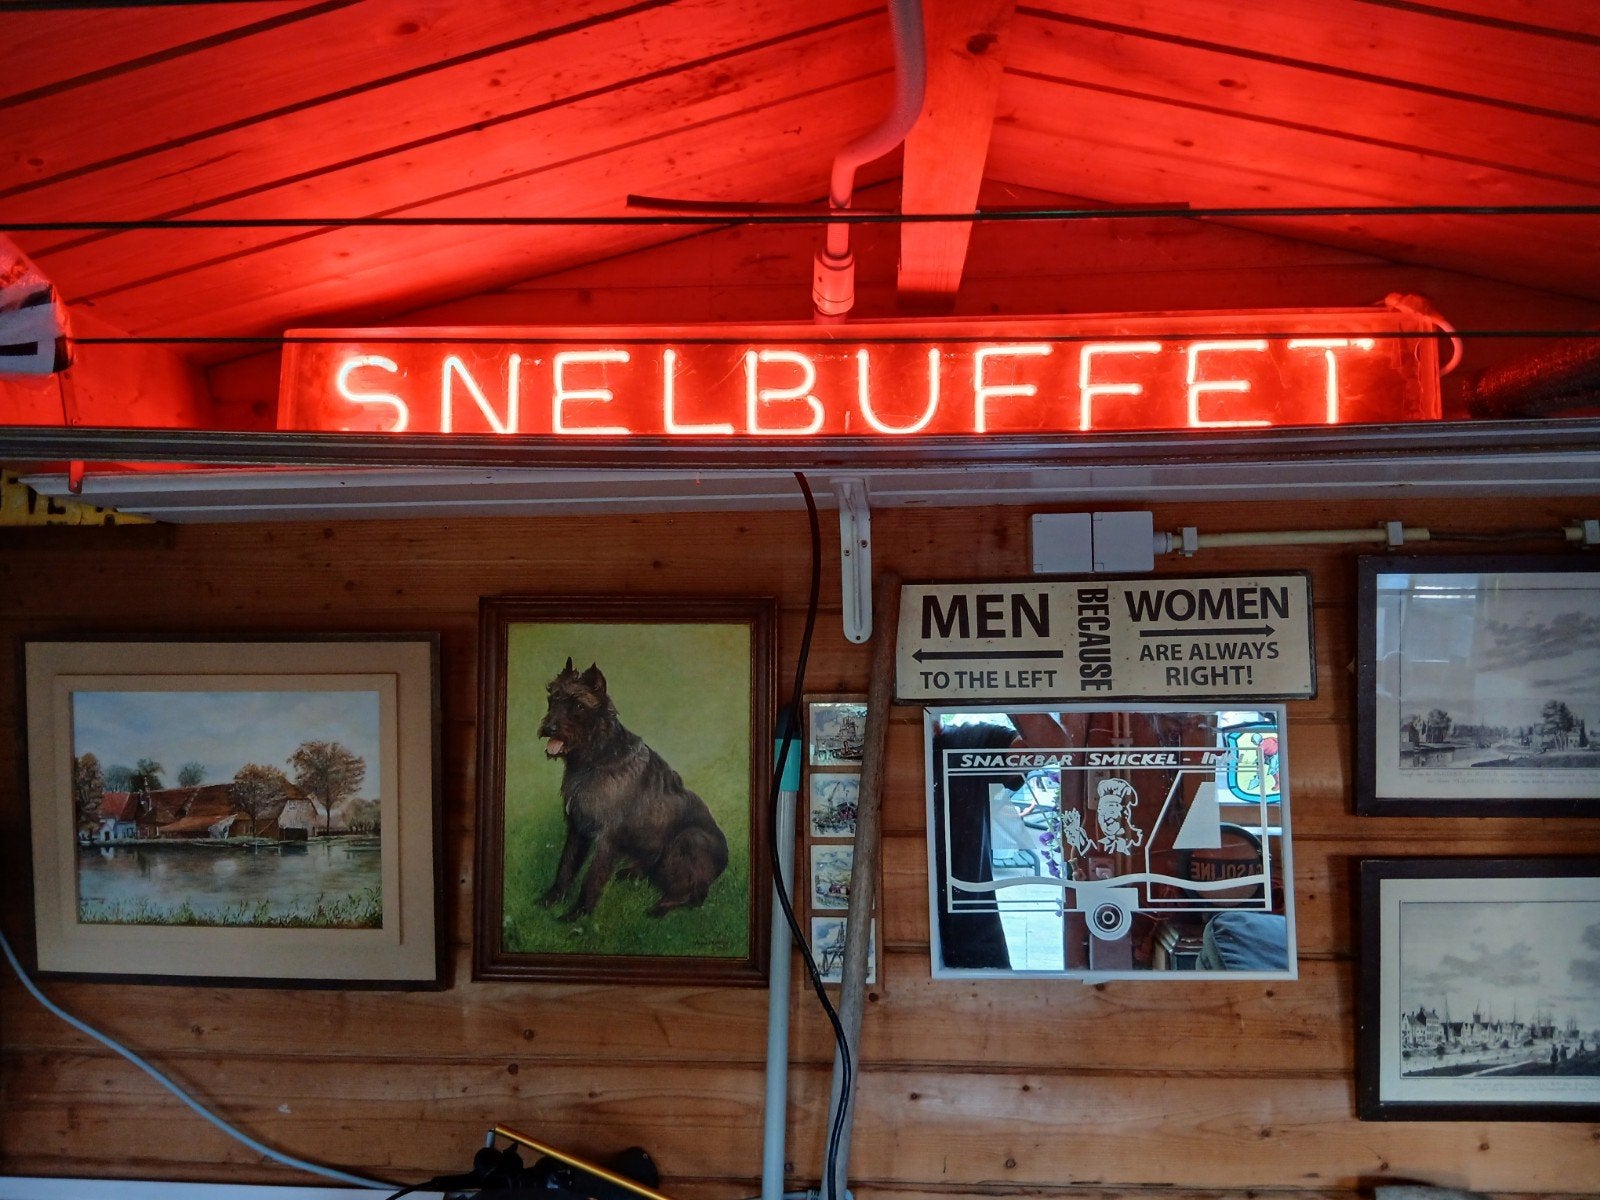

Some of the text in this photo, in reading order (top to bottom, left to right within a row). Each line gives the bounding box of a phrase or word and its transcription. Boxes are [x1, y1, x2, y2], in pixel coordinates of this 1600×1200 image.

[335, 338, 1375, 434] SNELBUFFET
[920, 593, 1050, 639] MEN
[1124, 586, 1290, 622] WOMEN
[1076, 588, 1112, 691] BECAUSE
[1139, 641, 1280, 662] ARE ALWAYS
[920, 669, 1058, 689] TO THE LEFT
[1165, 665, 1253, 686] RIGHT!
[960, 753, 1074, 767] SNACKBAR
[1088, 753, 1178, 766] SMICKEL
